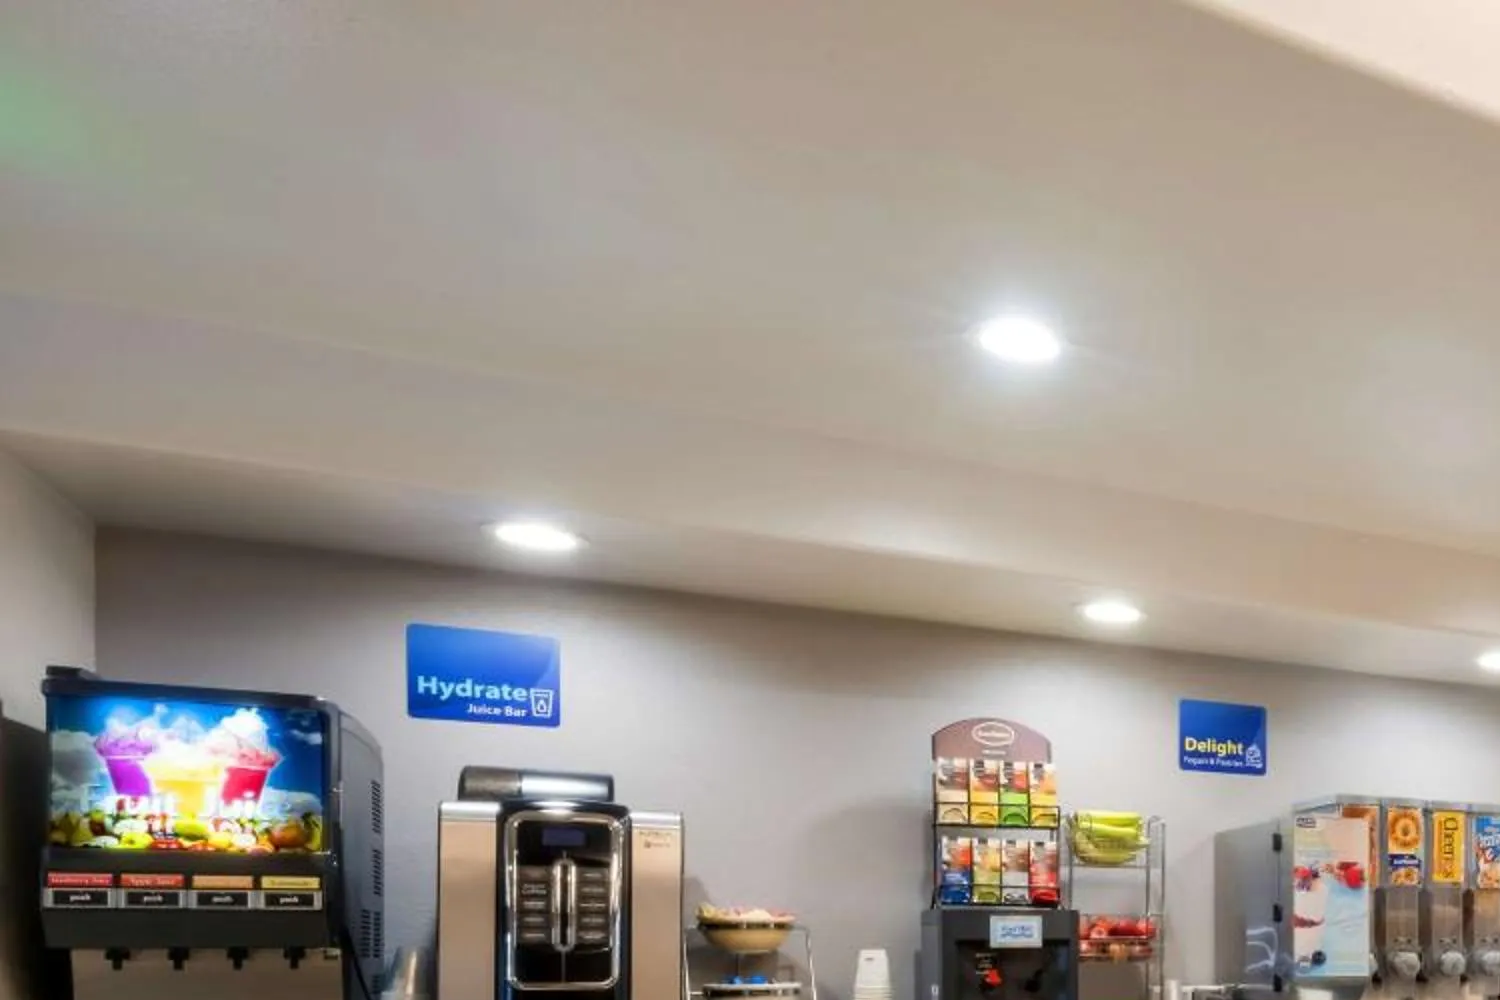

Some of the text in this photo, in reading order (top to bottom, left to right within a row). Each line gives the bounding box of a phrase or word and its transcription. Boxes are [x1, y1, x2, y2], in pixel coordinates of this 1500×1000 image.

[416, 675, 528, 701] Hydrate
[467, 703, 528, 717] Juice Bar
[1185, 737, 1244, 757] Delight
